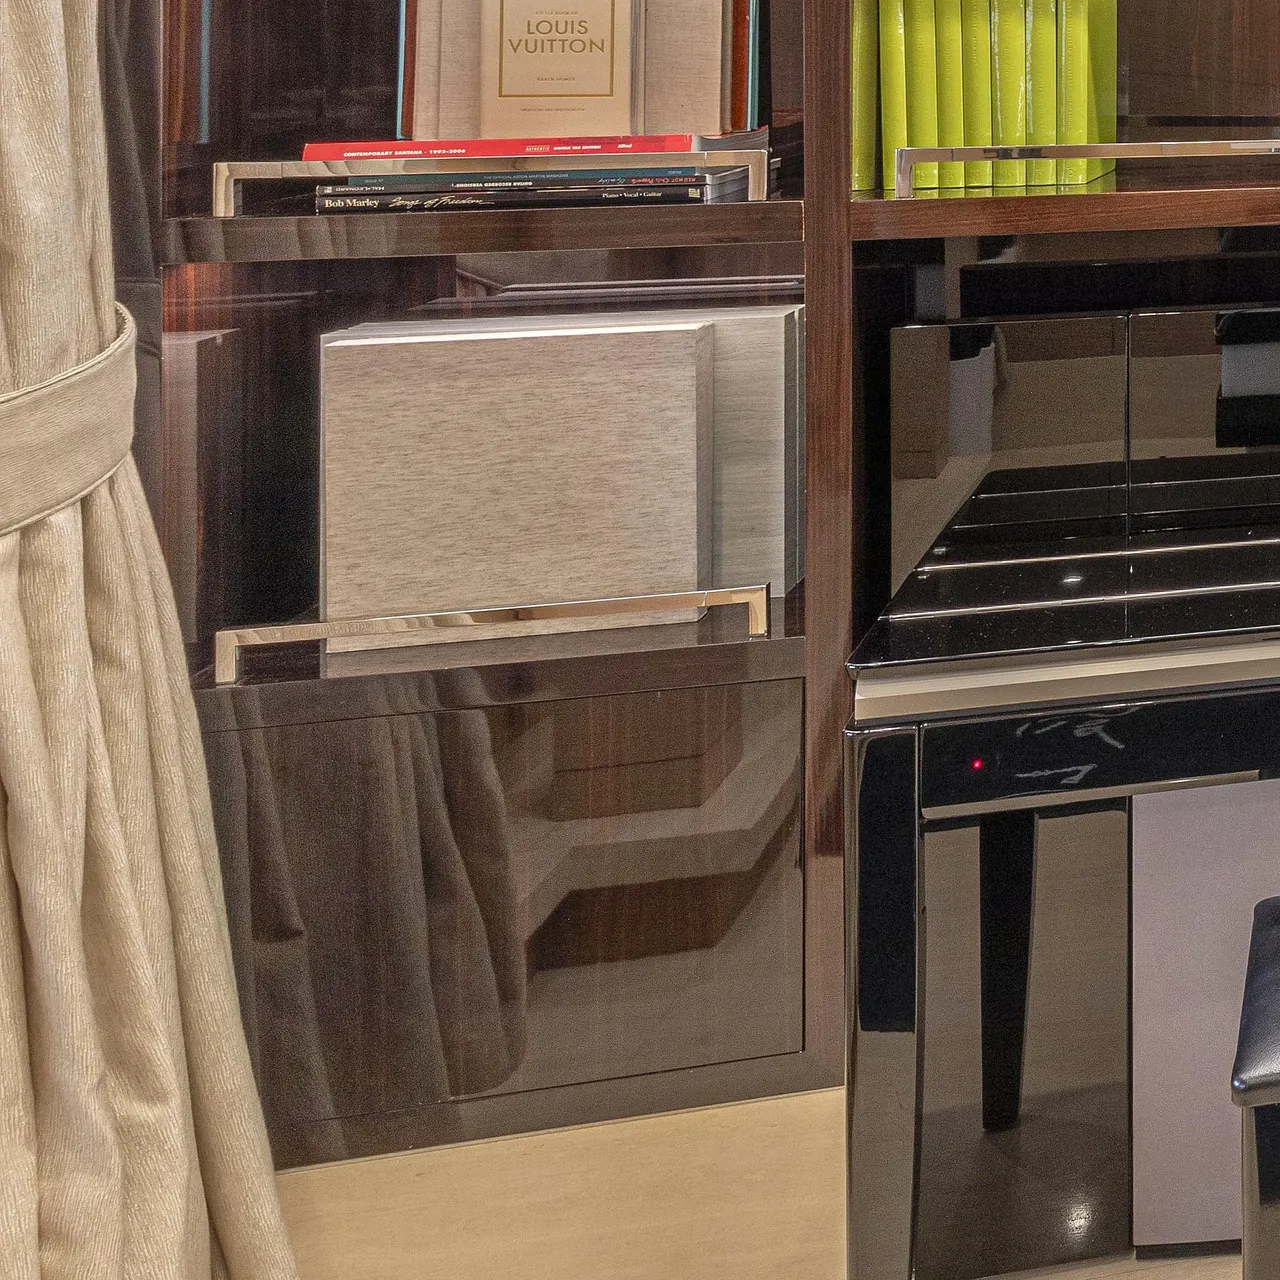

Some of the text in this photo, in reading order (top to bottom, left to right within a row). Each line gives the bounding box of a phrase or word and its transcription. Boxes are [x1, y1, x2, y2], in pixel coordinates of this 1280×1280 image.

[526, 20, 588, 35] LOUIS
[508, 38, 606, 54] VUITTON
[325, 199, 344, 208] Bob
[346, 198, 380, 208] Marley
